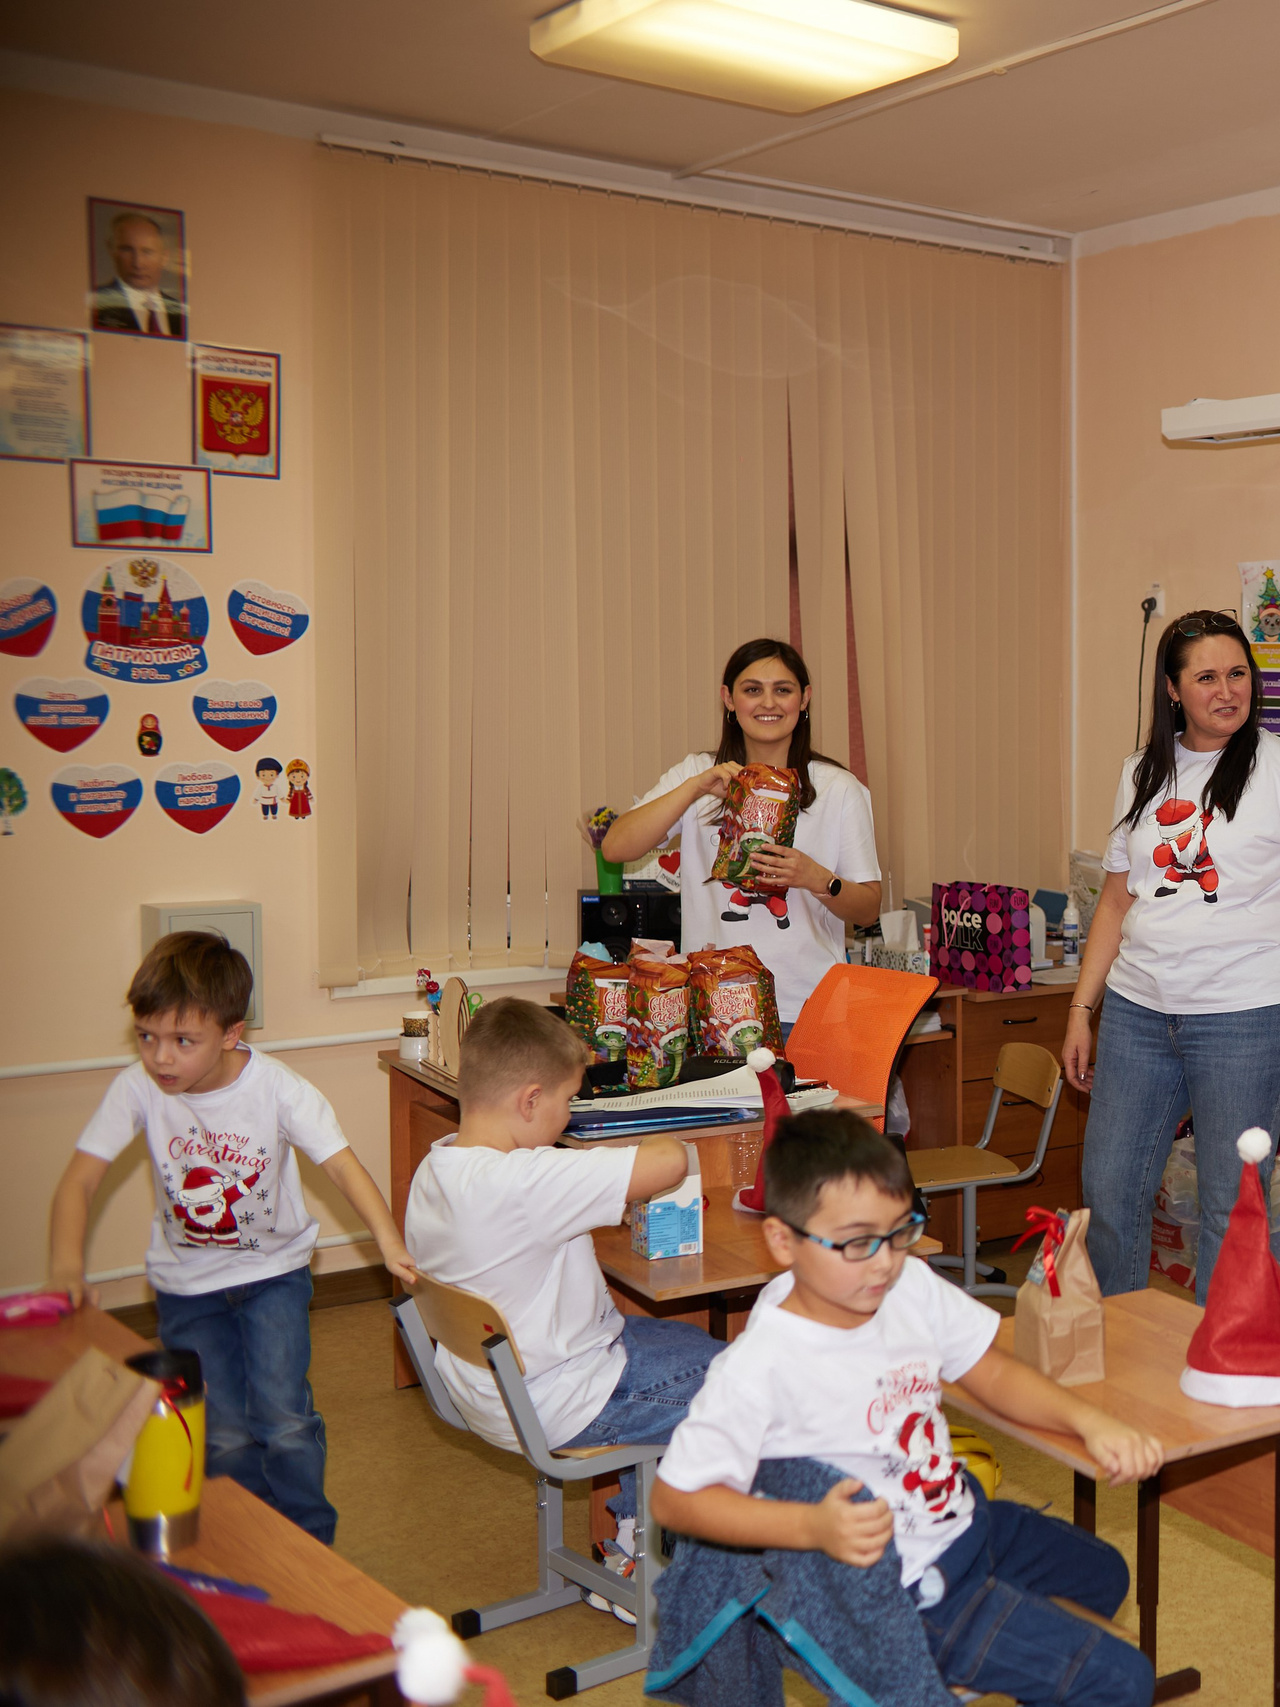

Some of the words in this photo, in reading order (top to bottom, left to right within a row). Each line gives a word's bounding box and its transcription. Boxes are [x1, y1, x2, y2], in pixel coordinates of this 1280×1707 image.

[244, 590, 296, 616] Готовность
[243, 602, 292, 626] защищать
[238, 612, 291, 637] Отечество!
[208, 700, 236, 708] Знать
[238, 700, 263, 708] свою
[202, 710, 270, 721] родословную!
[176, 773, 214, 782] Любовь
[174, 786, 183, 795] к
[184, 784, 218, 794] своему
[178, 794, 217, 806] народу!
[200, 1128, 250, 1150] Merry
[168, 1136, 272, 1174] Christmas
